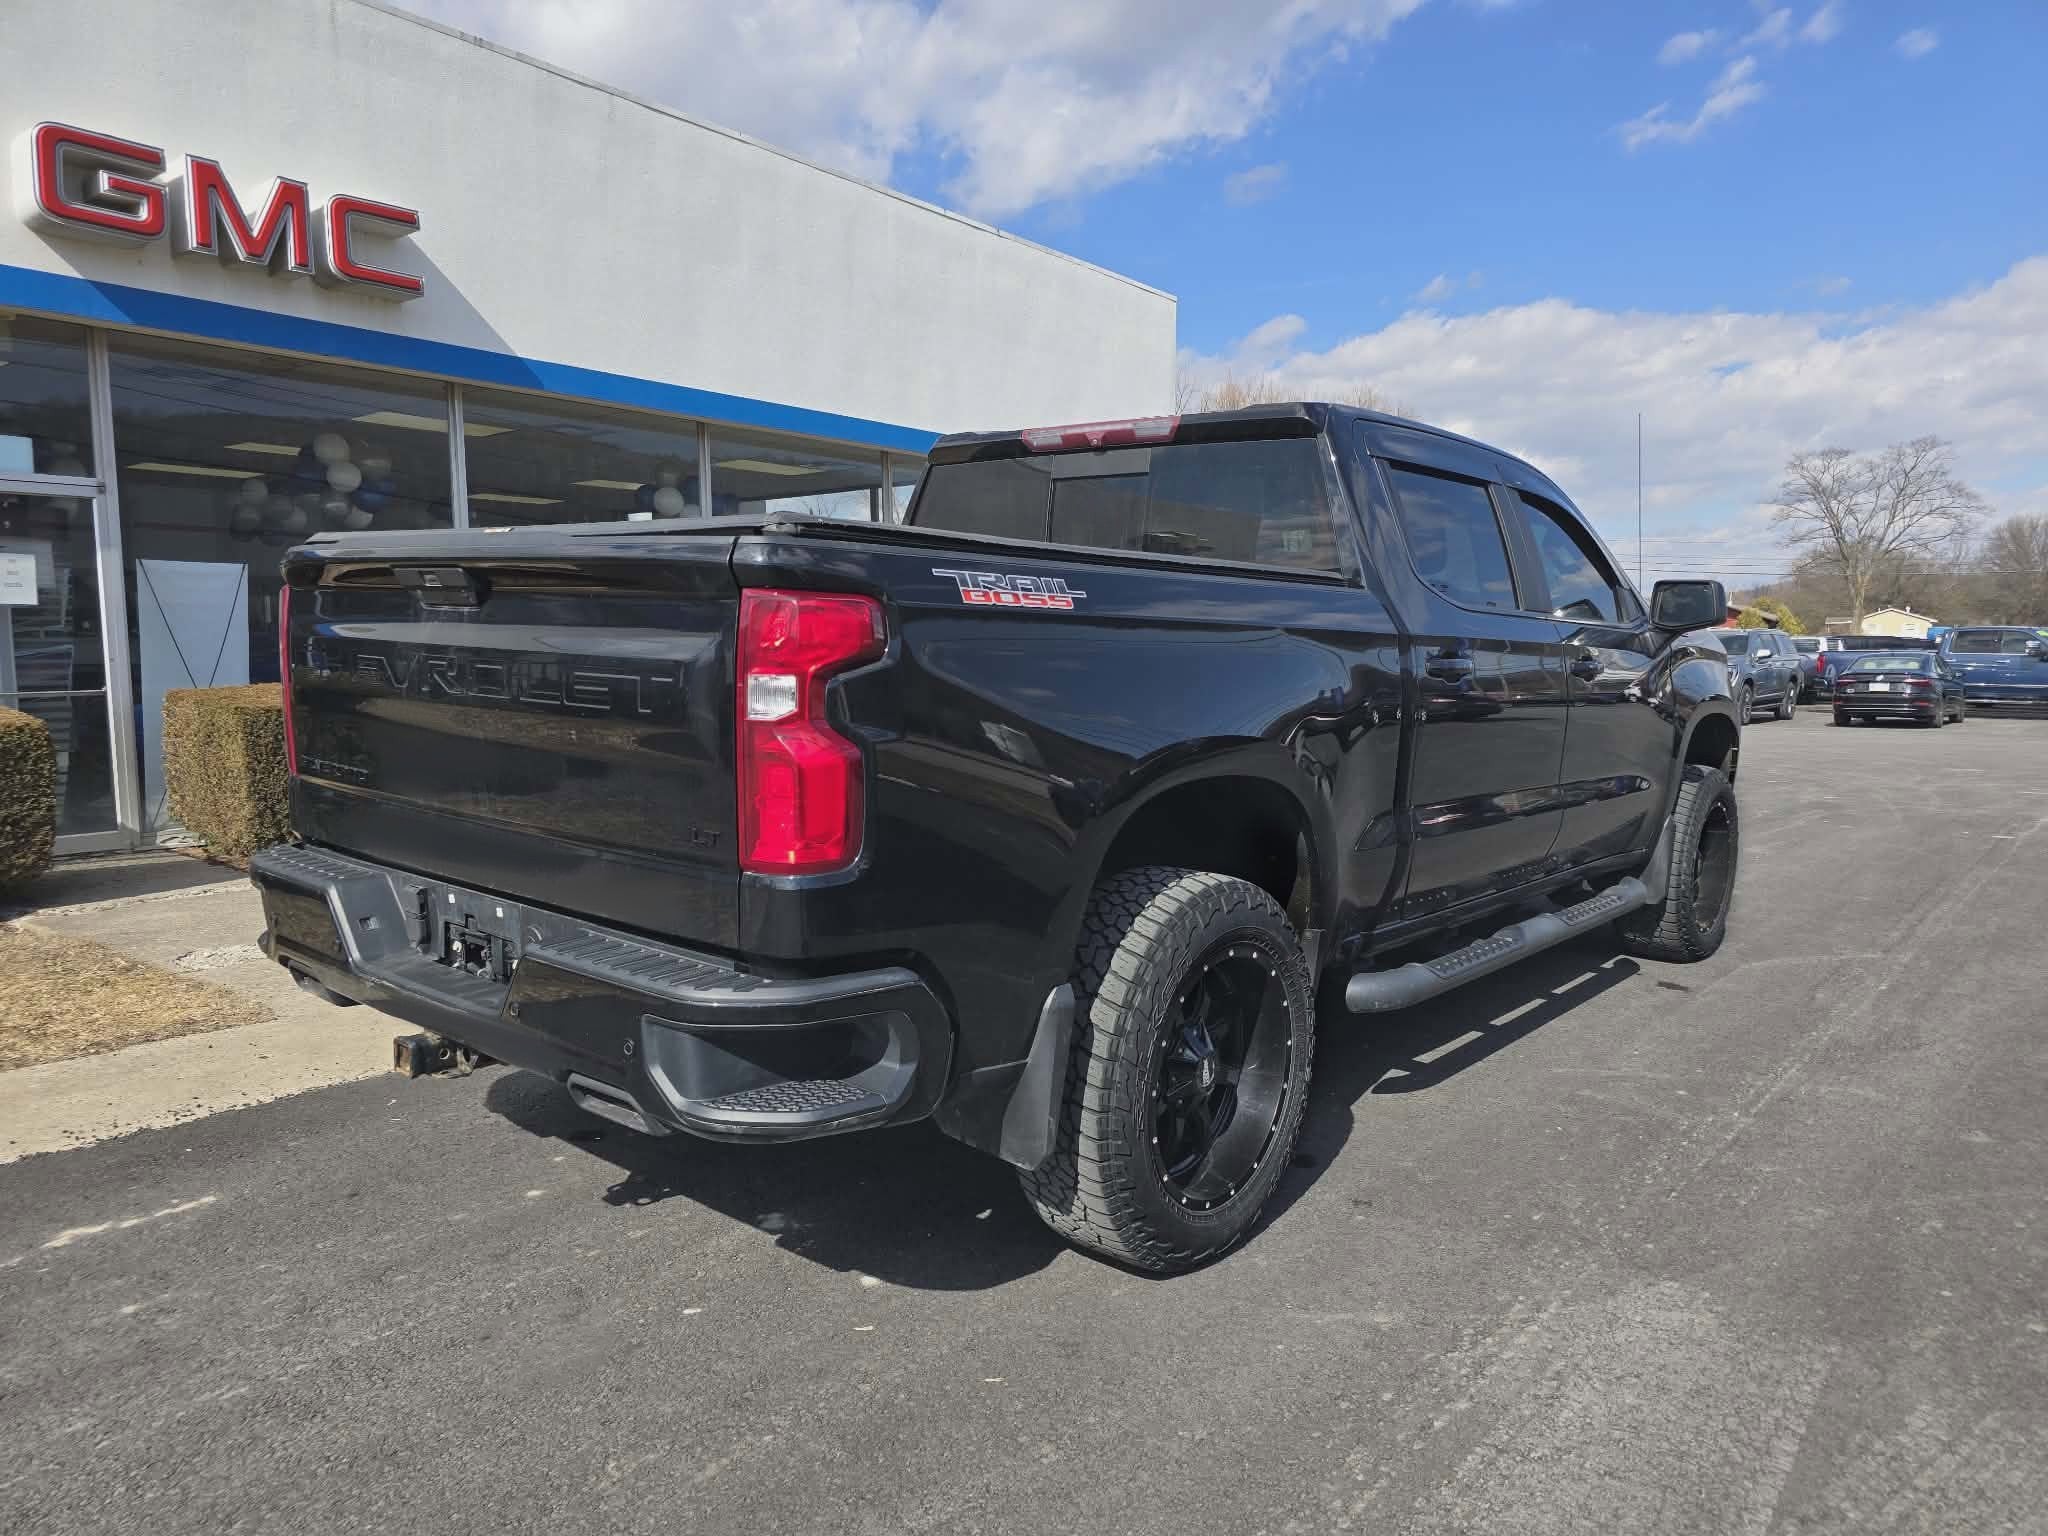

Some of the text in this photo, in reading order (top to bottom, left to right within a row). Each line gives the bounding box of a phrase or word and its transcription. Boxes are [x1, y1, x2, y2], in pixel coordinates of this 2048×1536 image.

[30, 121, 424, 298] GMC
[931, 567, 1088, 598] TRAIL
[960, 588, 1075, 610] BOSS
[305, 636, 687, 714] CEVROLET
